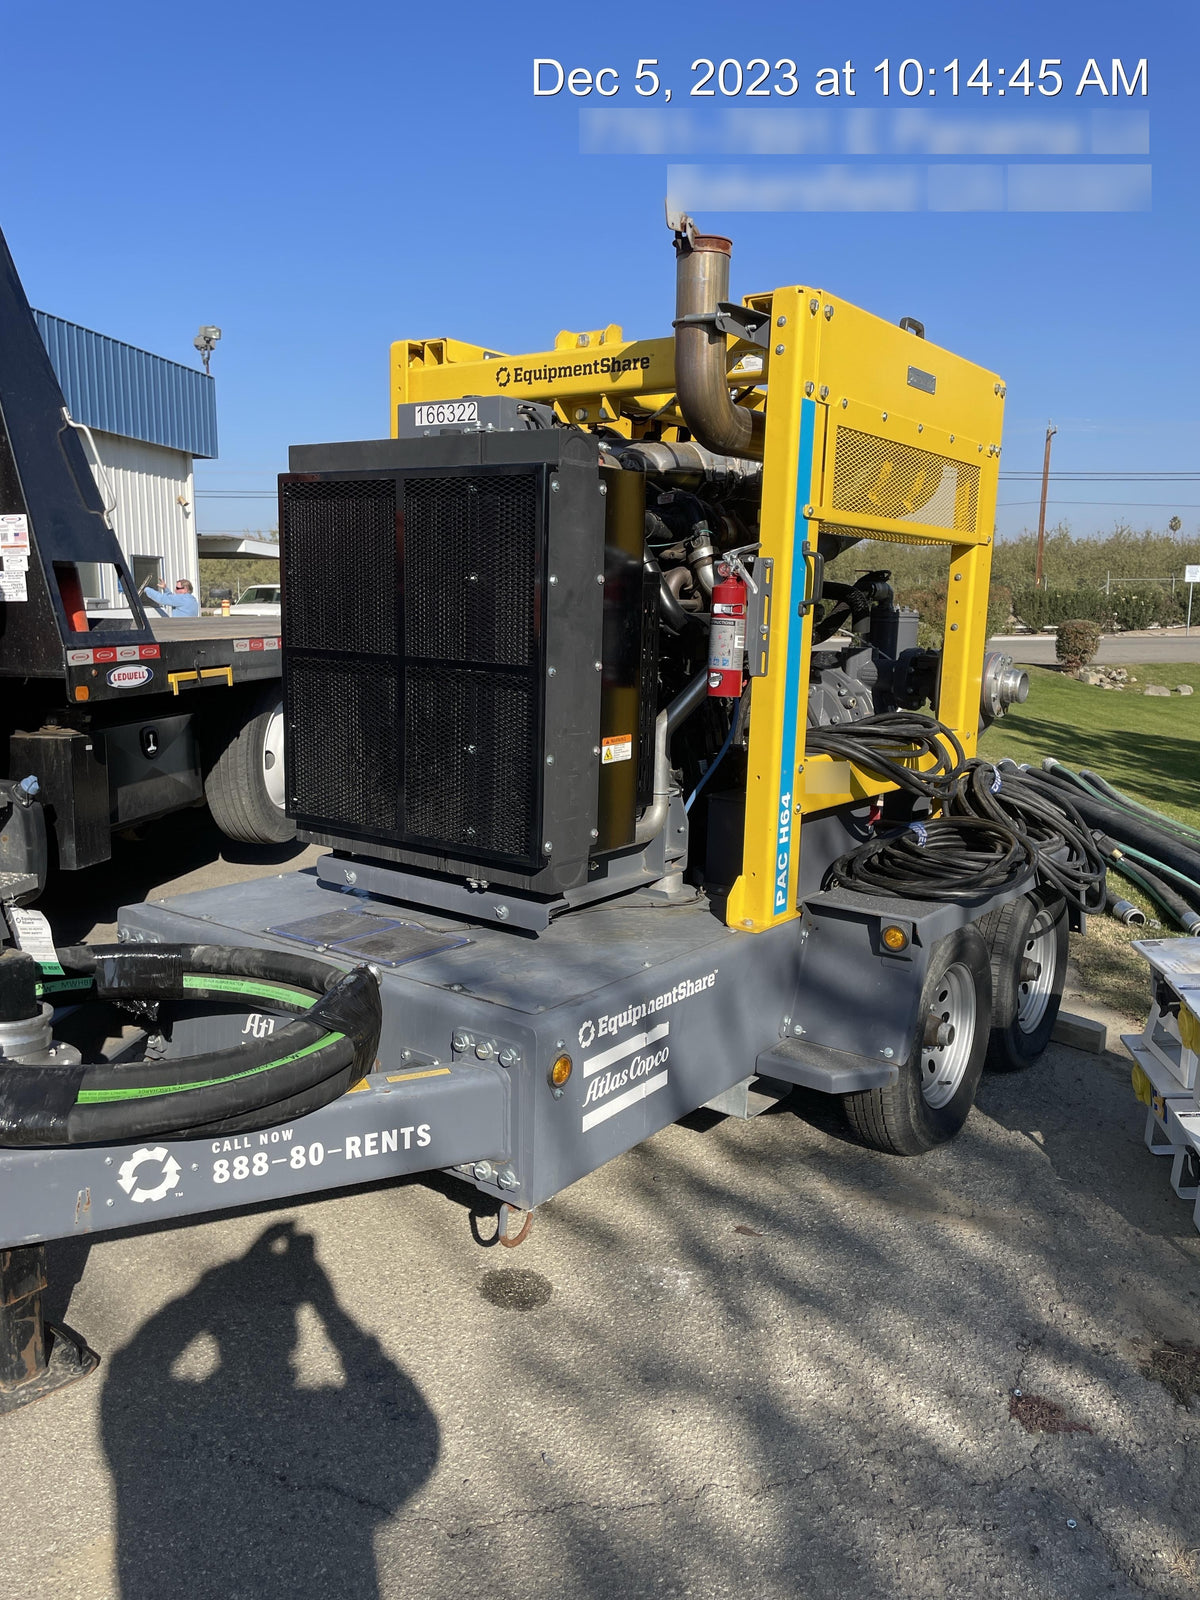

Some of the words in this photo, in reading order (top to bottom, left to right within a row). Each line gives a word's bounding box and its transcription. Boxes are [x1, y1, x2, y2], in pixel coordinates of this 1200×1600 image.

[513, 356, 651, 385] EquipmentShare
[416, 402, 477, 425] 166322
[113, 671, 146, 682] LEDWELL
[779, 792, 791, 844] H64
[775, 852, 788, 907] PAC
[241, 1013, 275, 1038] Atl
[582, 1069, 629, 1107] Atlas
[630, 1046, 670, 1080] Copco
[211, 1137, 251, 1154] CALL
[259, 1128, 294, 1145] NOW
[212, 1123, 433, 1184] 888-80-RENTS
